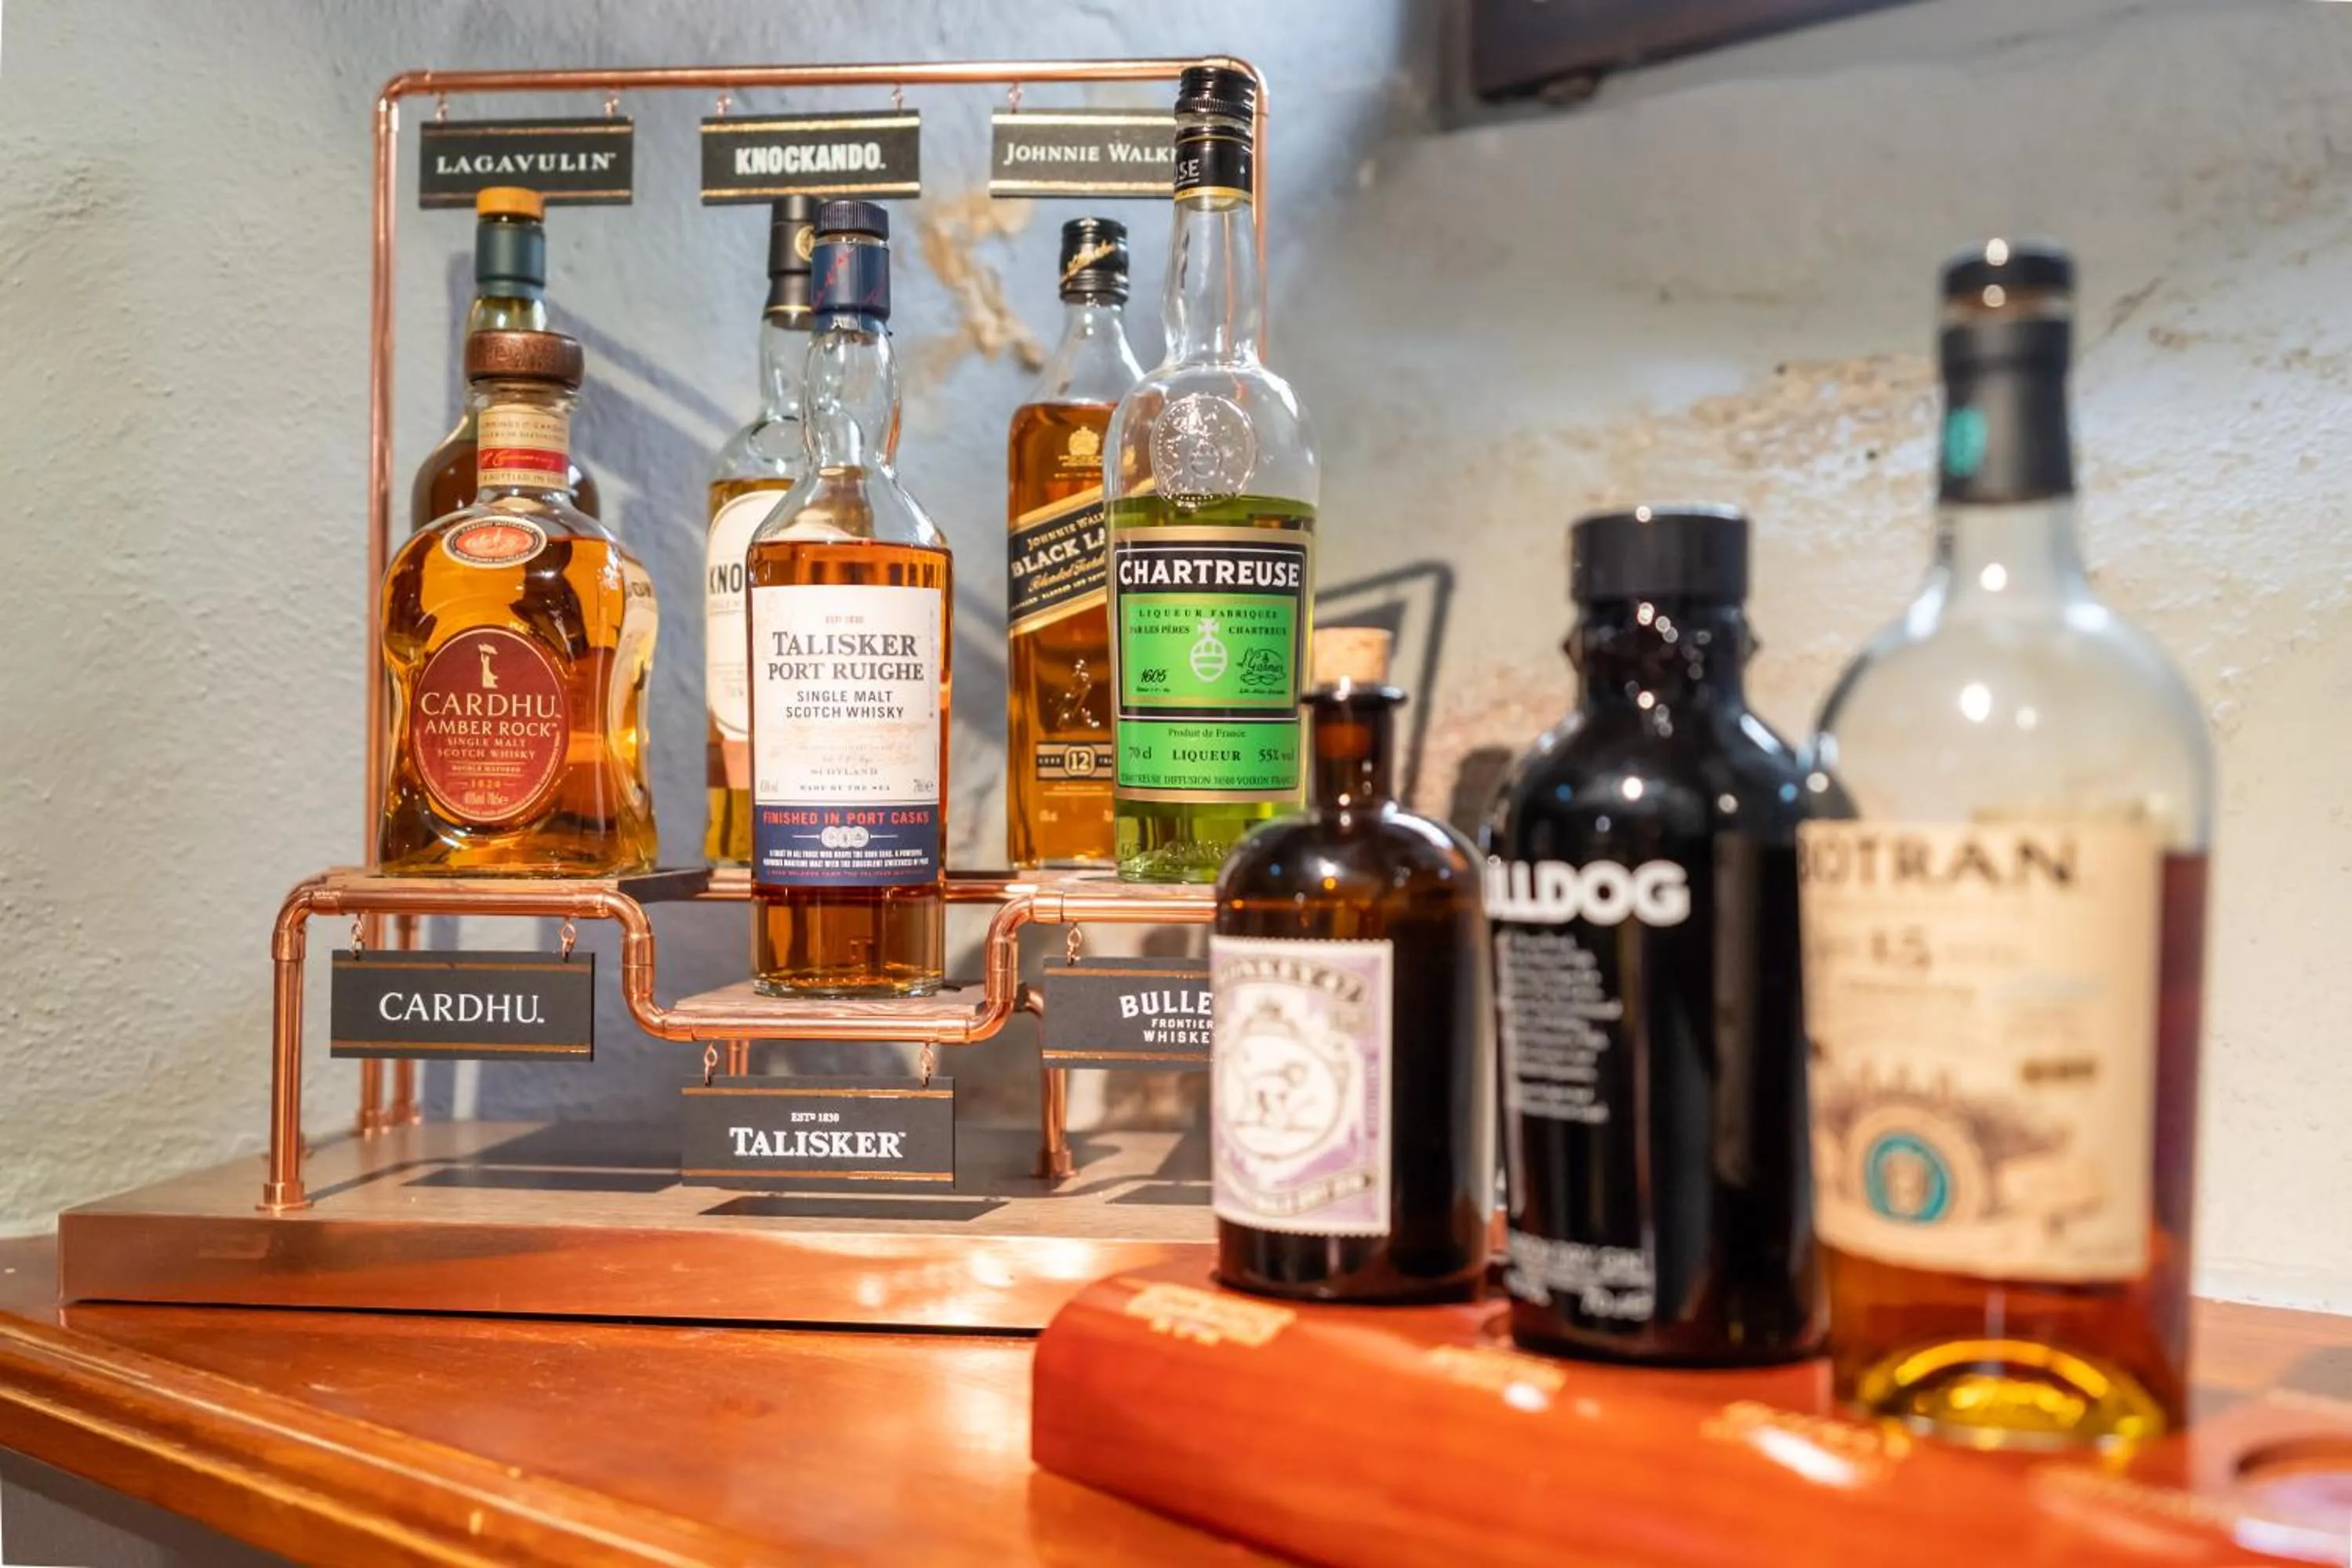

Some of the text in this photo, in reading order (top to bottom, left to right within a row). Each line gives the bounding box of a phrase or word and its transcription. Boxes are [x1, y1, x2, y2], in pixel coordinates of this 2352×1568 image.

[1004, 142, 1175, 165] JOHNNIE WALK
[1027, 523, 1076, 551] JOHNNIE
[1011, 539, 1081, 577] BLACK
[1119, 558, 1301, 587] CHARTREUSE
[1139, 608, 1202, 619] LIQUEUR
[772, 630, 918, 657] TALISKER
[768, 662, 924, 681] PORT RUIGHE
[421, 692, 557, 719] CARDHU
[797, 690, 892, 703] SINGLE MALT
[786, 706, 905, 719] SCOTCH WHISKY
[424, 720, 550, 738] AMBER ROCK
[447, 736, 526, 747] SINGLE MALT
[437, 749, 535, 760] SCOTCH WHISKY
[1070, 752, 1090, 771] 12
[1172, 750, 1241, 762] LIQUEUR
[763, 811, 930, 825] FINISHED IN PORT CASKS
[1484, 858, 1691, 927] LLDOG
[1119, 989, 1214, 1018] BULLE
[1151, 1018, 1214, 1029] FRONTIER
[1143, 1029, 1210, 1044] WHISKE
[729, 1127, 904, 1158] TALISKER
